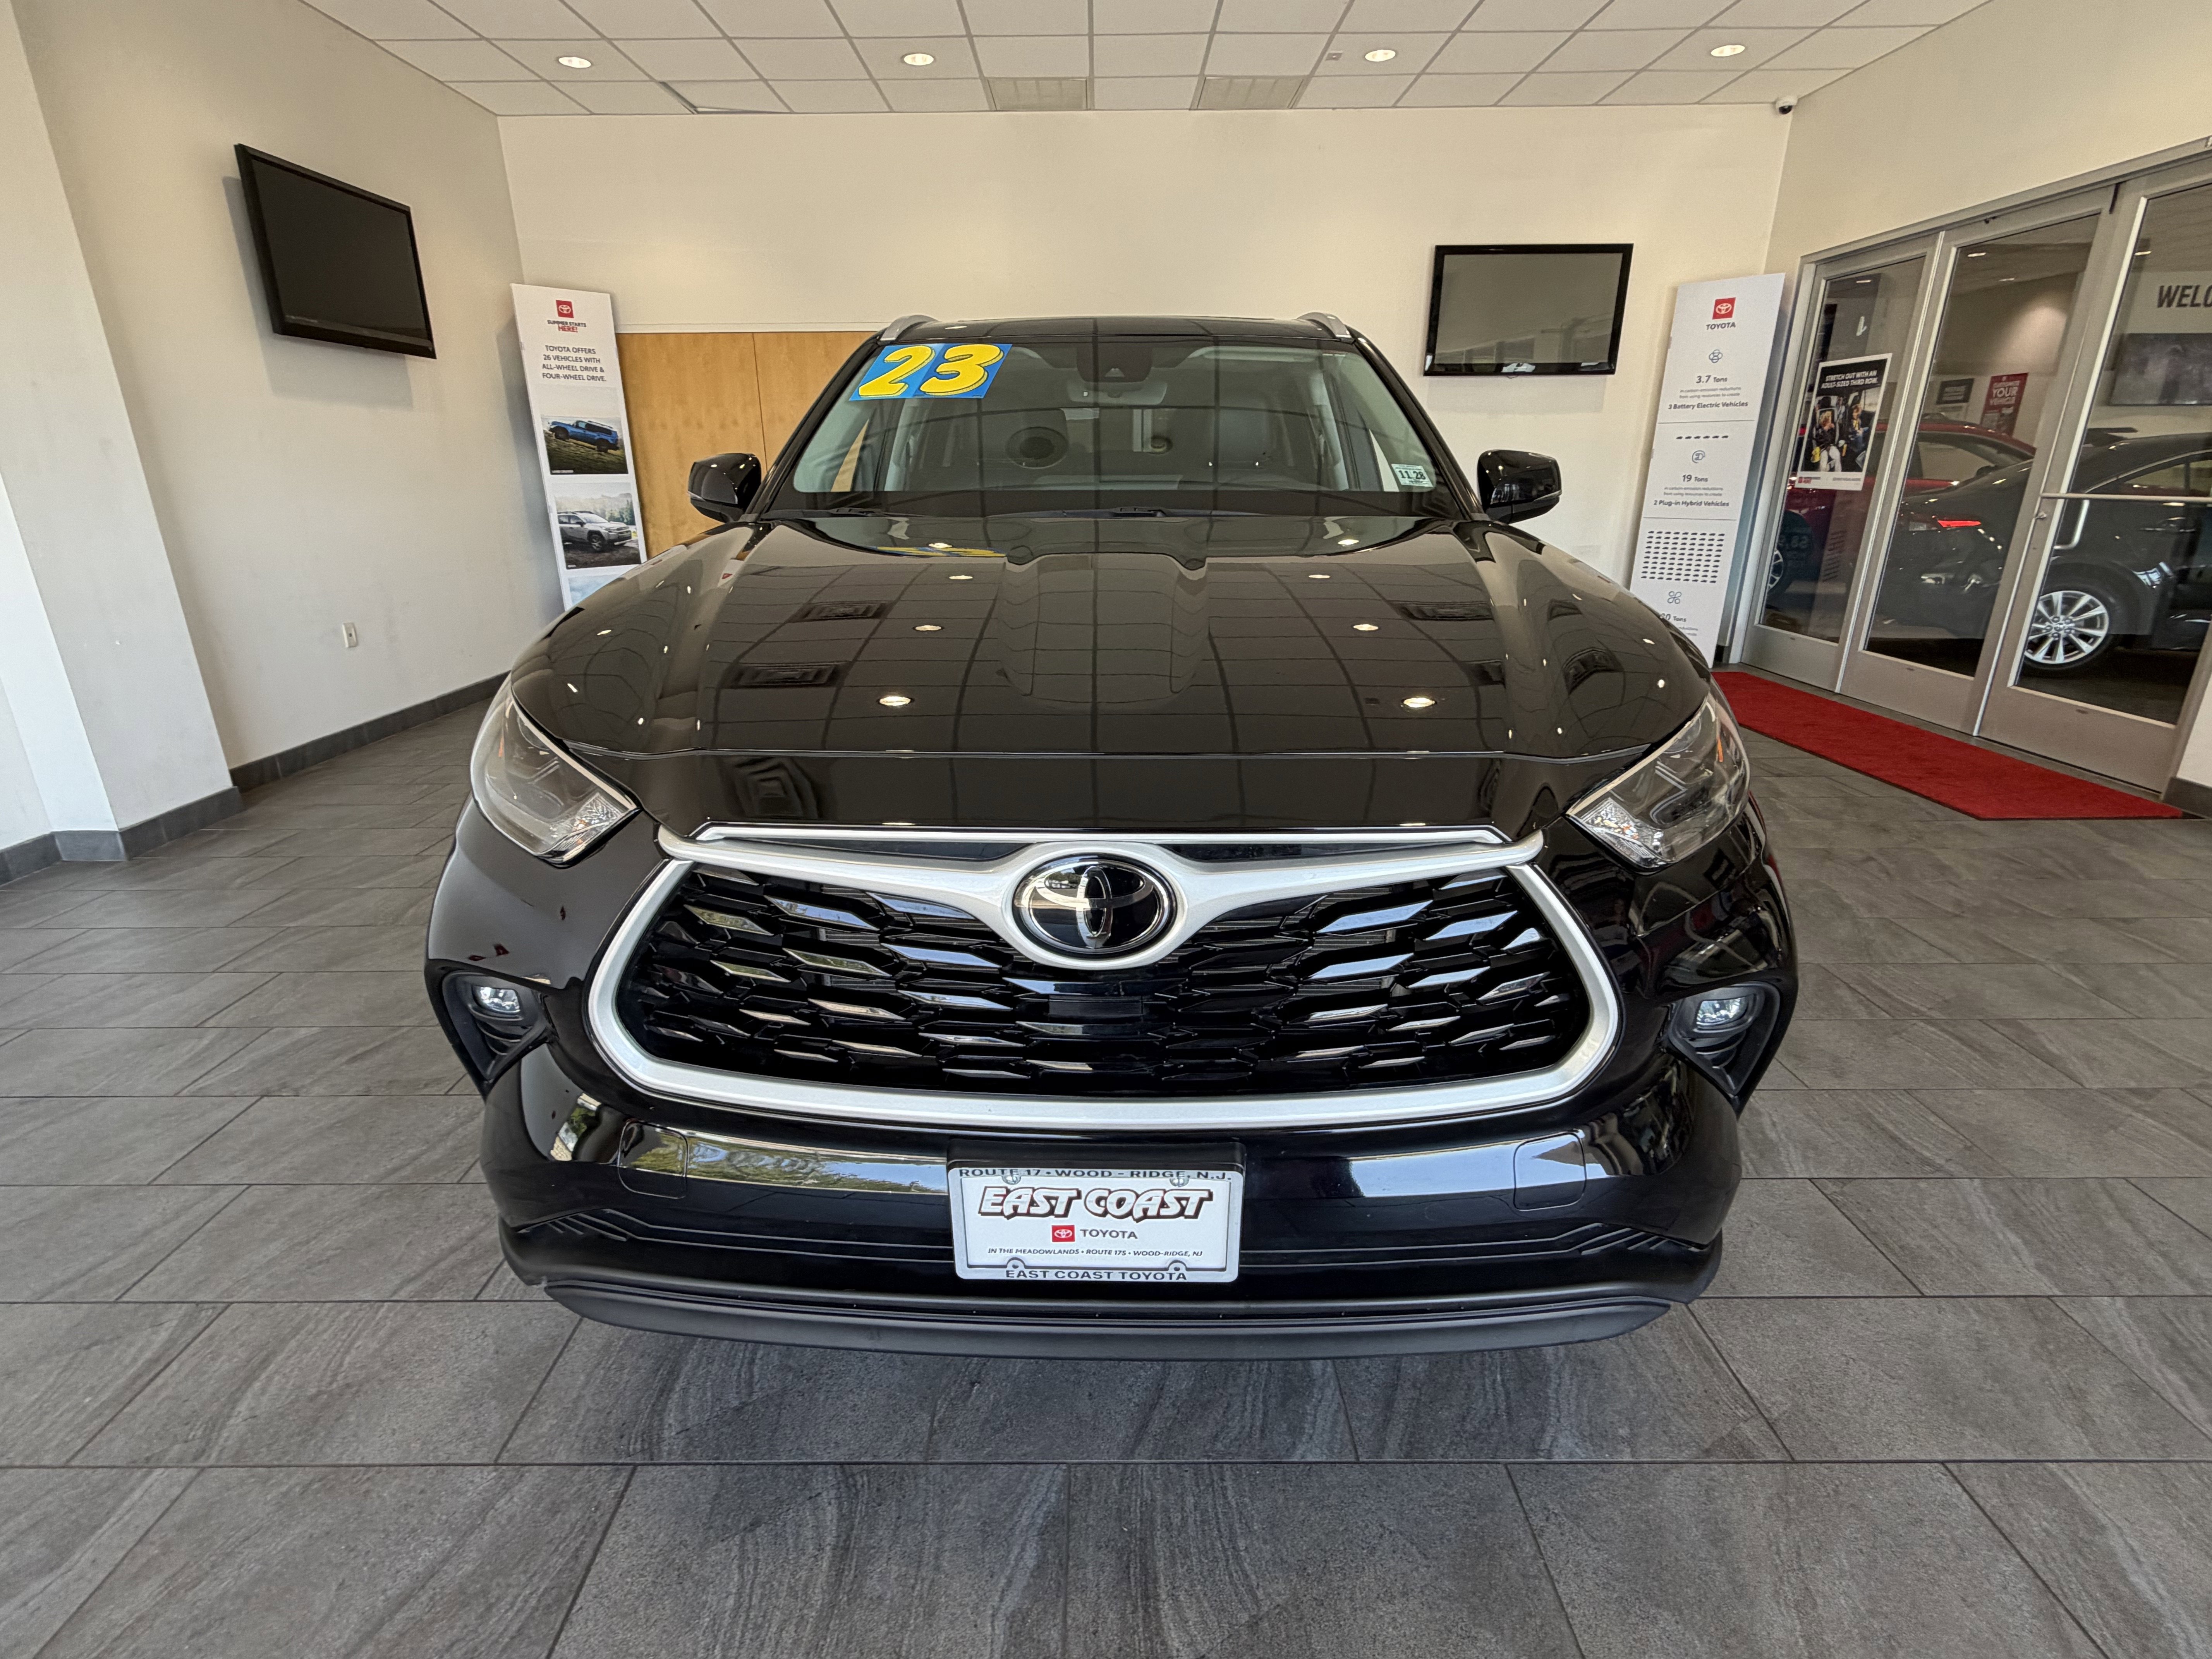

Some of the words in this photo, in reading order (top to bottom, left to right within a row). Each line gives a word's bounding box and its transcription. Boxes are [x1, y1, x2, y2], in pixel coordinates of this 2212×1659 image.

[1705, 322, 1736, 330] TOYOTA
[552, 355, 583, 363] VEHICLES
[542, 363, 579, 371] ALL-WHEEL
[859, 344, 1004, 398] 23
[542, 373, 585, 381] FOUR-WHEEL
[1696, 375, 1711, 383] 3.7
[1825, 374, 1845, 382] STRETCH
[1992, 386, 2018, 398] YOUR
[1398, 470, 1412, 479] 11
[1413, 471, 1426, 480] 28
[959, 1169, 1019, 1177] ROUTE
[1054, 1169, 1112, 1177] WOOD
[1196, 1171, 1232, 1180] N.J.
[978, 1186, 1082, 1219] EAST
[1084, 1187, 1213, 1223] COAST
[1080, 1229, 1138, 1239] TOYOTA
[1006, 1270, 1049, 1278] EAST
[1054, 1271, 1114, 1279] COAST
[1118, 1271, 1187, 1281] TOYOTA
